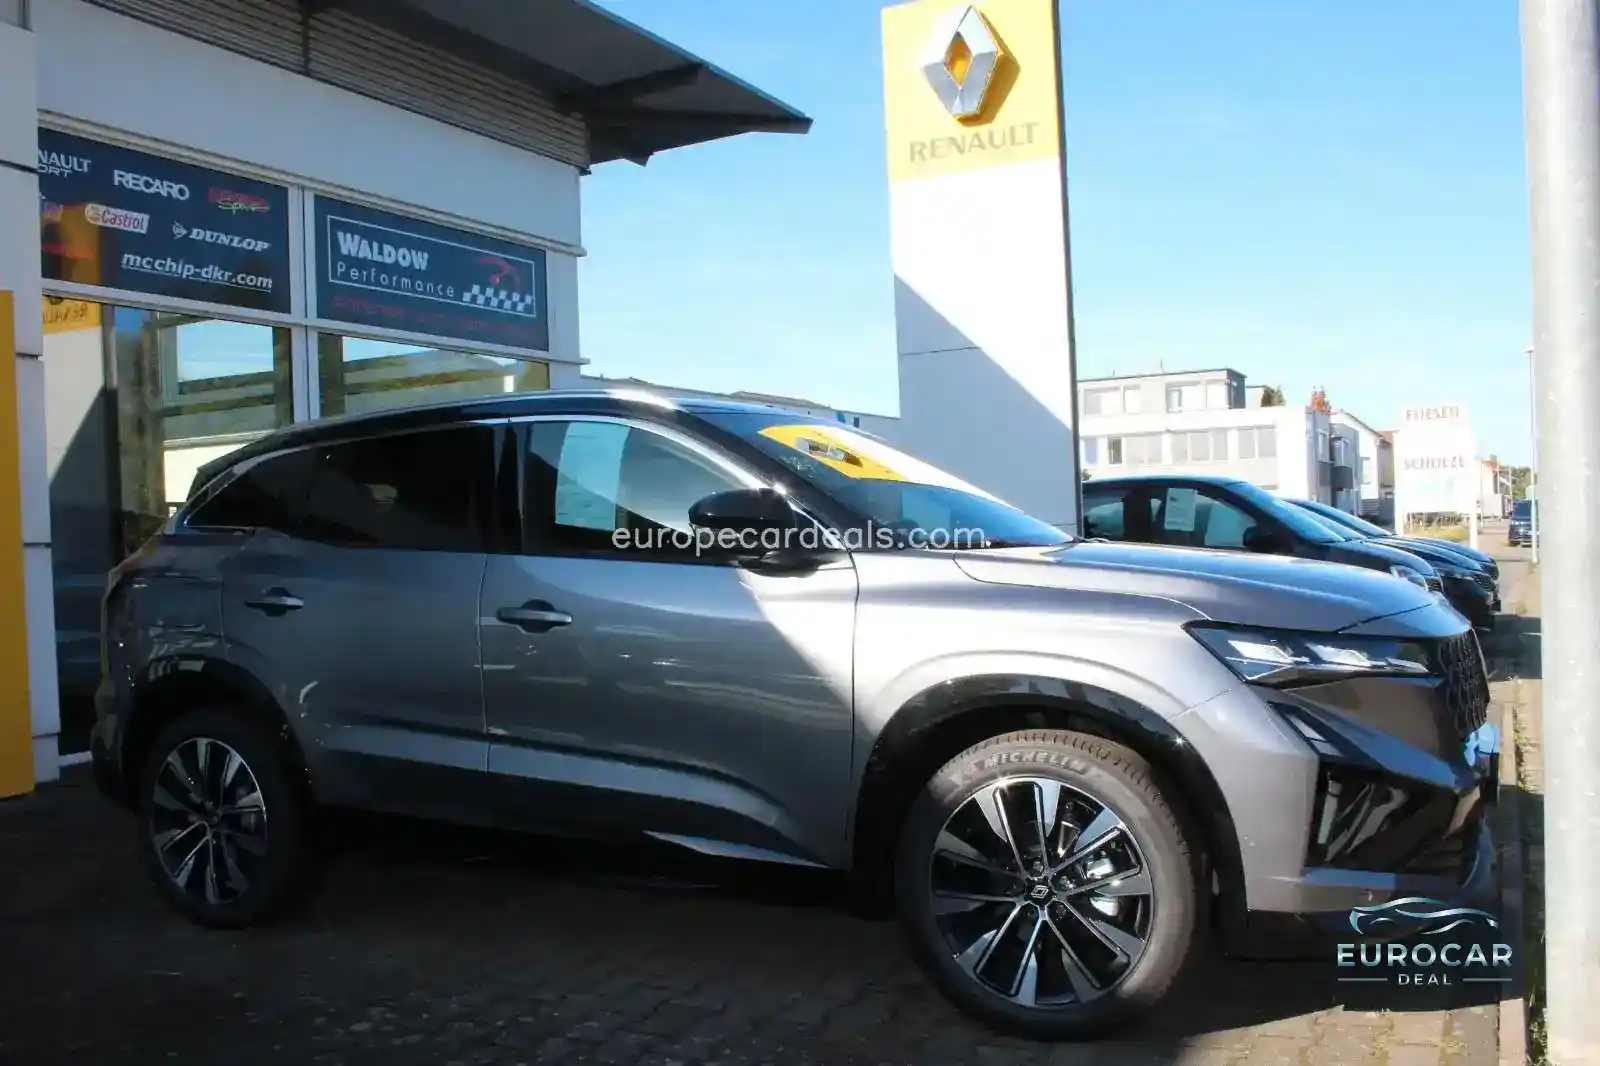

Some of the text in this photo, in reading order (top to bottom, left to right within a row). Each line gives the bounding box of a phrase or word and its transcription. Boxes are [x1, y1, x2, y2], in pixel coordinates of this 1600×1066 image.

[909, 122, 1039, 162] RENAULT
[38, 149, 92, 173] NAULT
[113, 170, 190, 201] RECARO
[101, 210, 146, 233] Castrol
[189, 228, 272, 252] DUNLOP
[336, 231, 429, 271] WALDOW
[121, 252, 273, 290] mcchip-dkr.com
[336, 261, 455, 298] Performance
